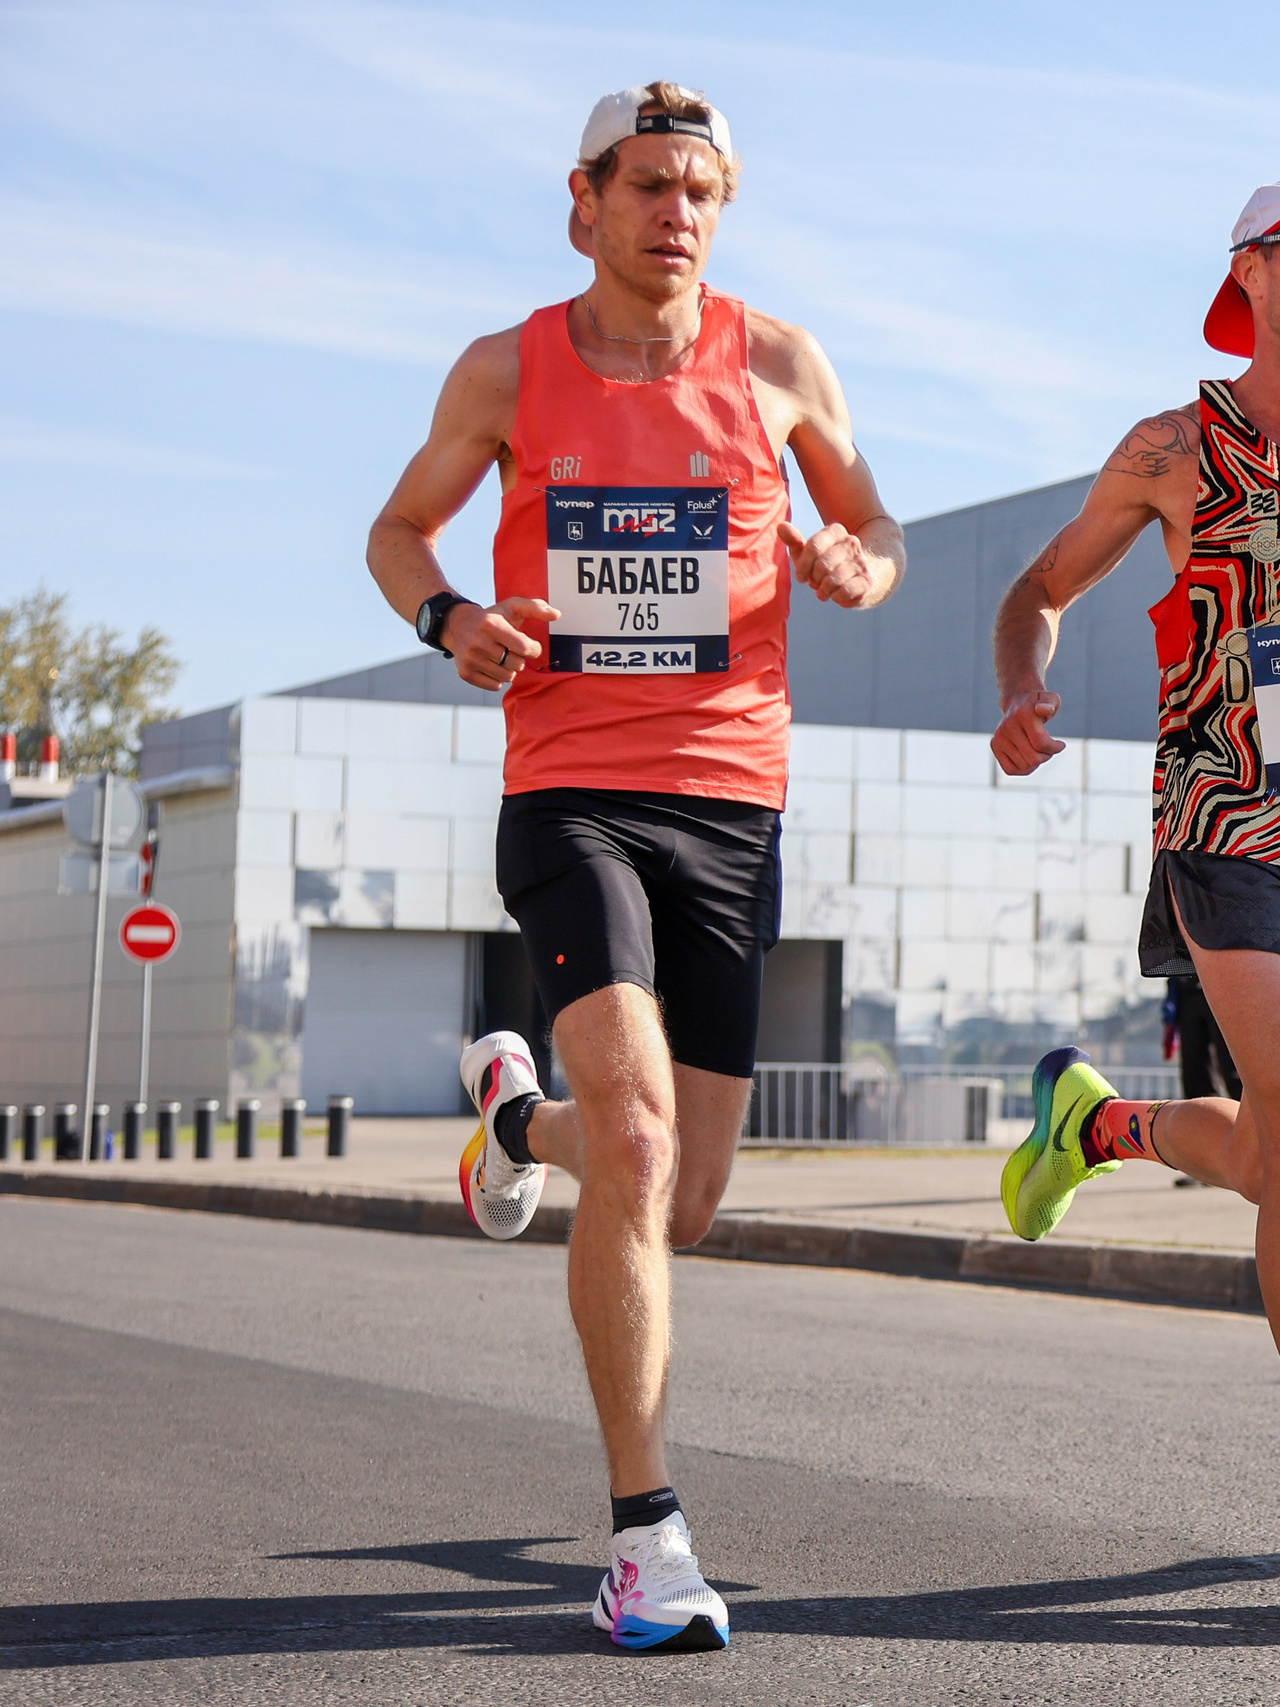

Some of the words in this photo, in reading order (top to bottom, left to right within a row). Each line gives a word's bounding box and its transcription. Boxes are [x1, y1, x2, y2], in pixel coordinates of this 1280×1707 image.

[577, 556, 700, 595] БАБАЕВ
[617, 603, 659, 631] 765
[586, 651, 647, 670] 42,2
